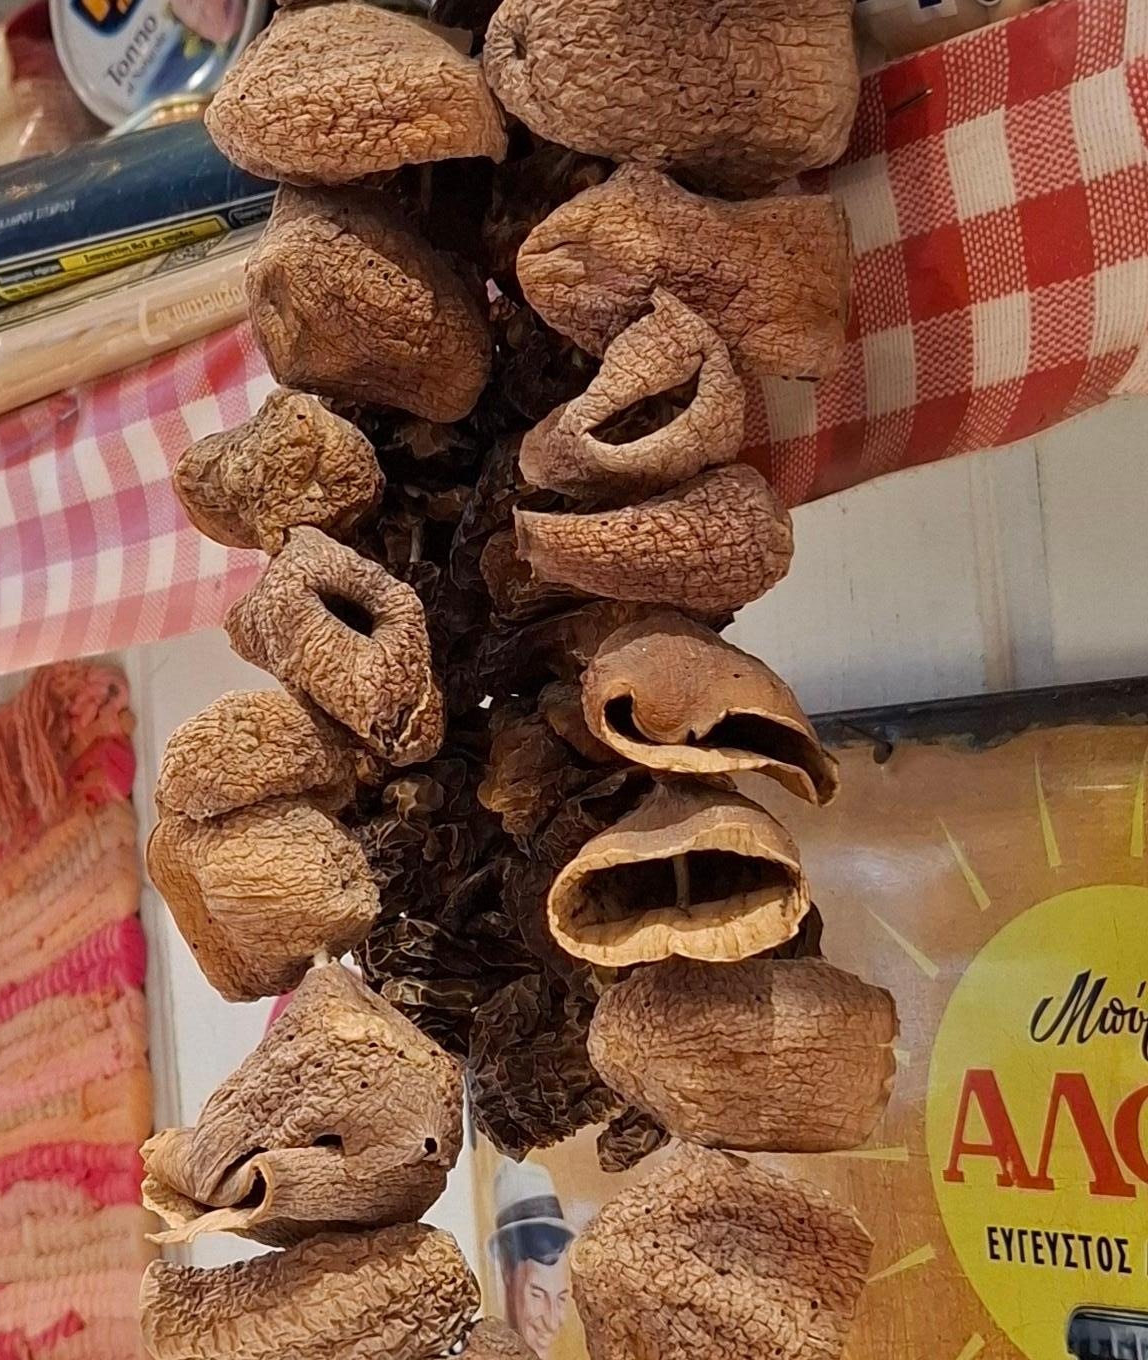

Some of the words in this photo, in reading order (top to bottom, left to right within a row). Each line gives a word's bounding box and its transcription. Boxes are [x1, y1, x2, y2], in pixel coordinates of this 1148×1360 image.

[106, 16, 158, 87] Tonno
[1030, 968, 1148, 1061] Μπύ
[987, 1226, 1132, 1274] ΕΥΓΕΥΣΤΟΣ
